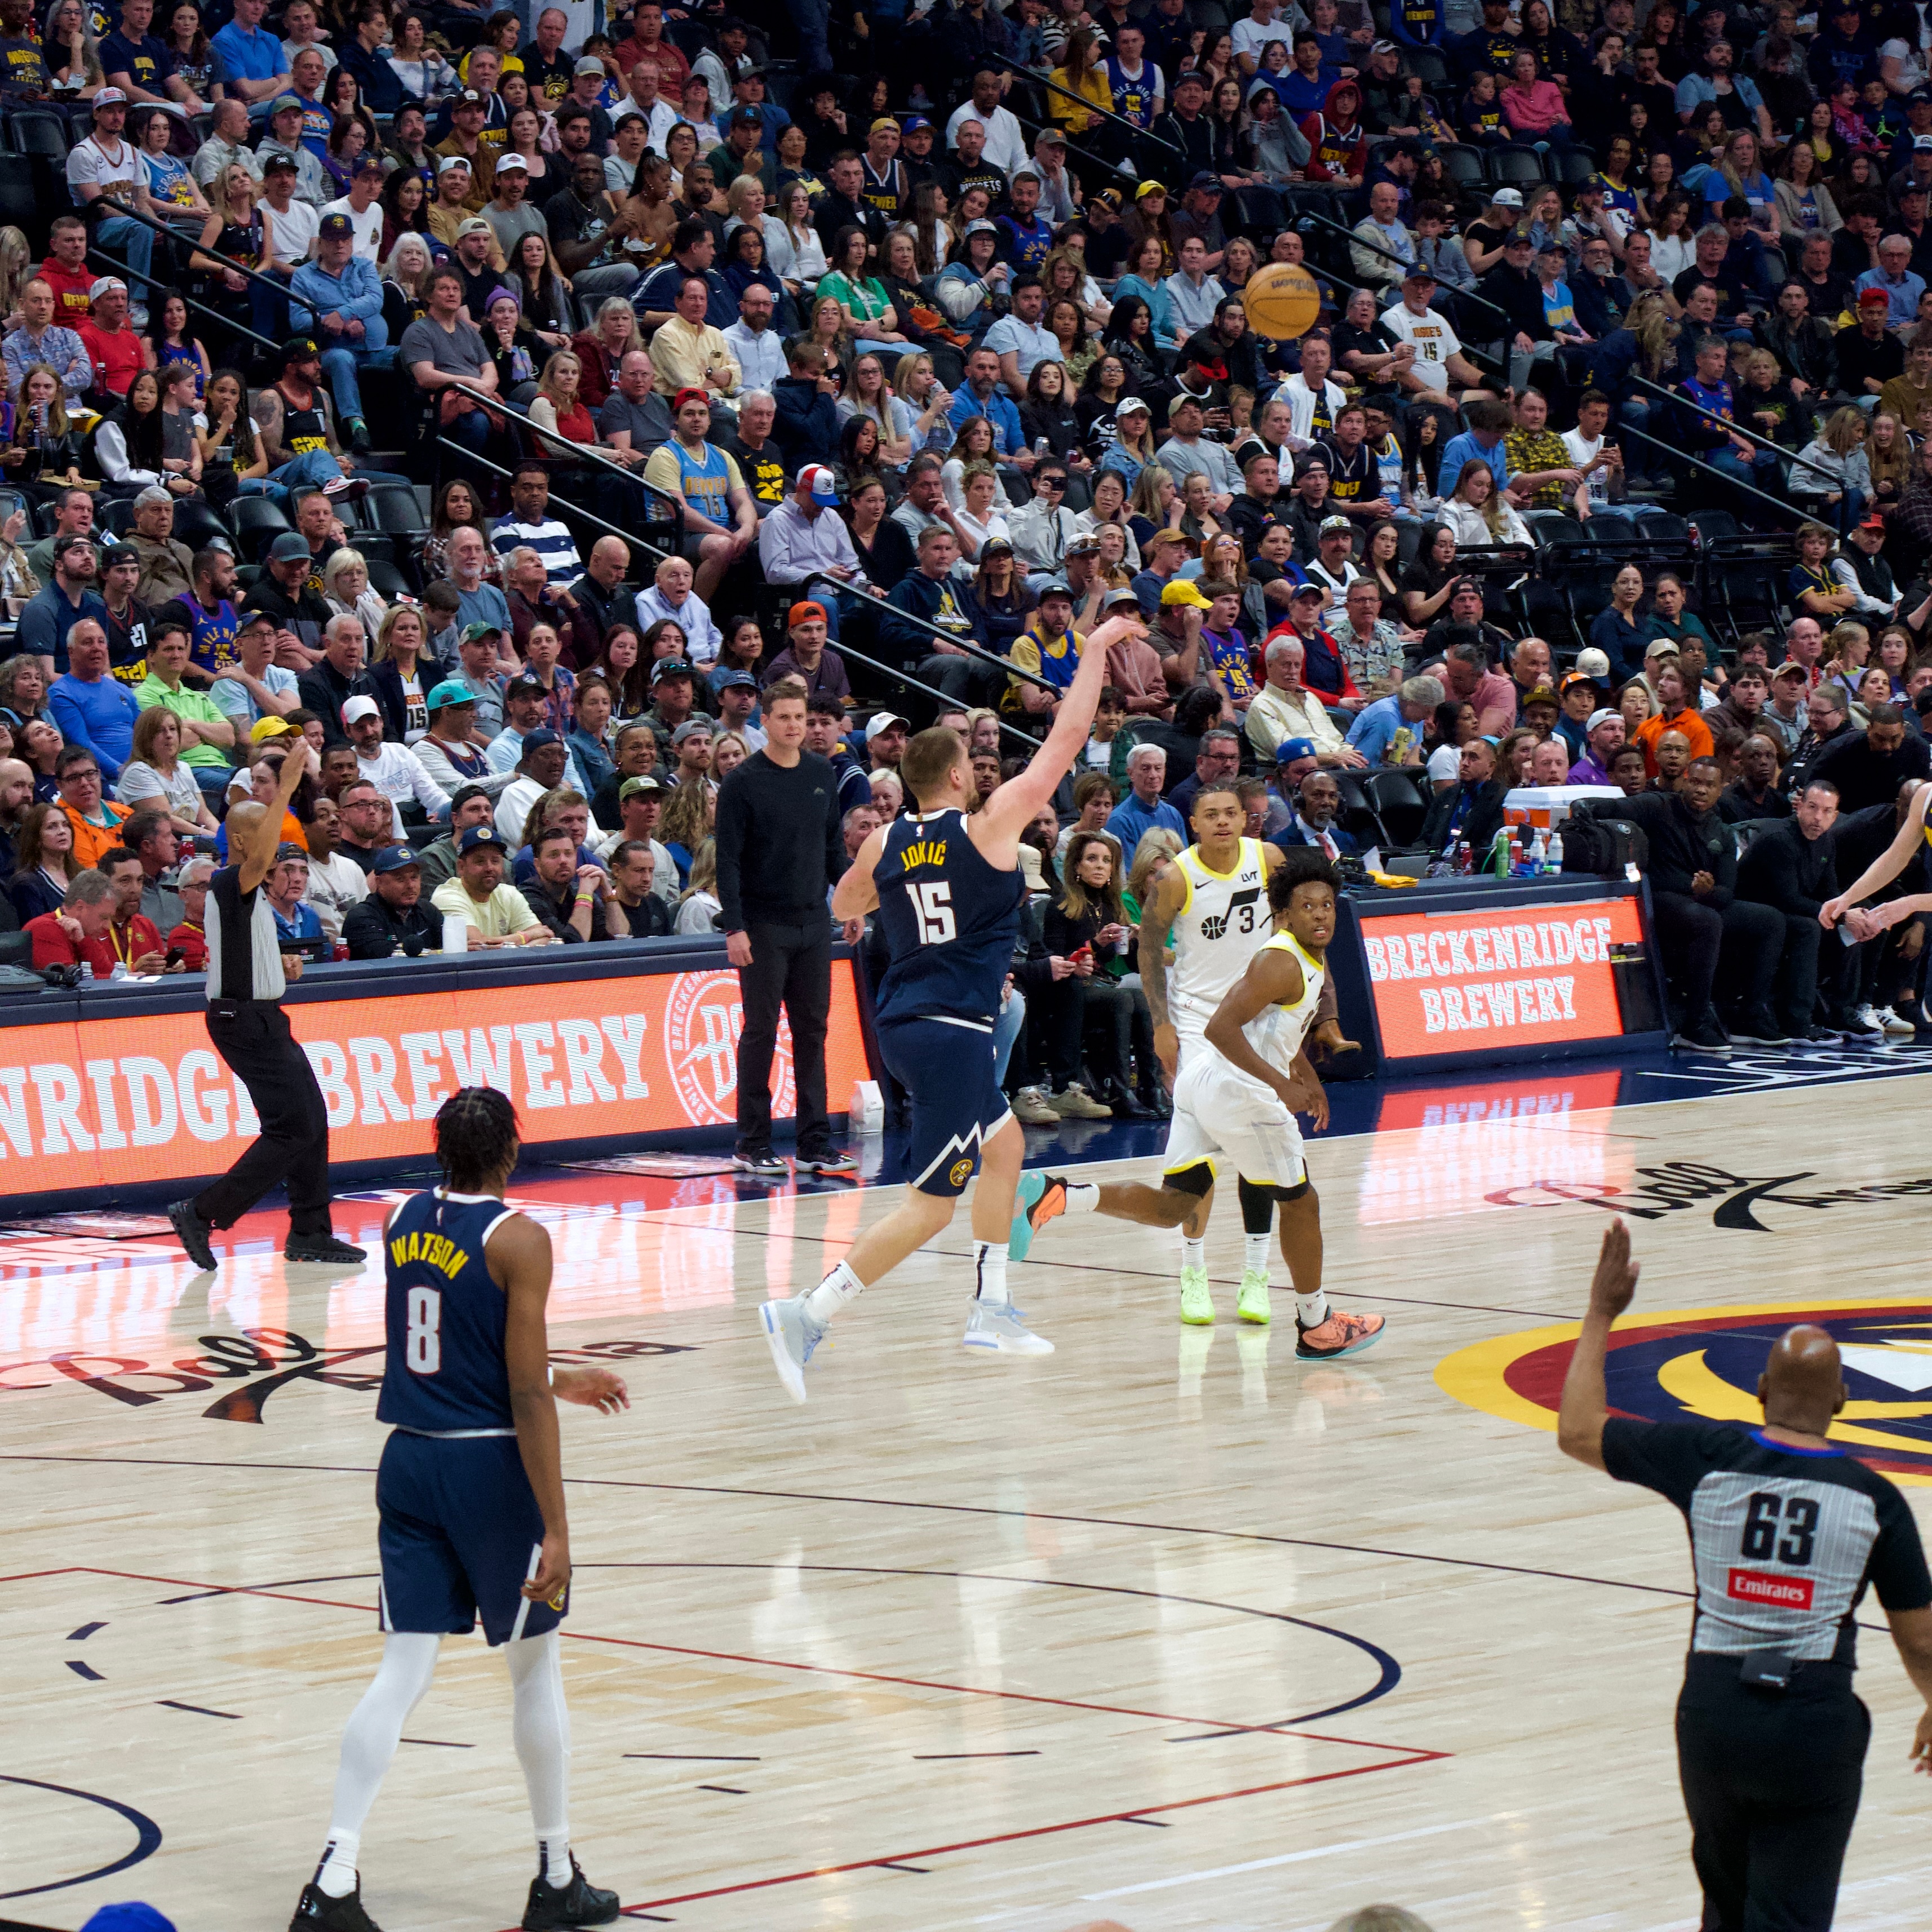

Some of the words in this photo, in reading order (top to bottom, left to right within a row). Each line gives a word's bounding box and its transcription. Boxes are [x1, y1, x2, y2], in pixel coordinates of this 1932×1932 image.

[901, 839, 947, 872] JOKIĆ
[1241, 871, 1257, 883] LVT
[905, 880, 957, 945] 15
[1239, 905, 1254, 934] 3
[1364, 918, 1612, 982] BRECKENRIDGE
[1420, 976, 1577, 1028] BREWERY
[300, 1014, 649, 1128] BREWERY
[1484, 1162, 1749, 1220] Ball
[390, 1230, 469, 1280] WATSON
[406, 1285, 441, 1376] 8
[0, 1327, 317, 1407] Ball
[1741, 1492, 1820, 1566] 63
[1734, 1576, 1805, 1602] Emirates
